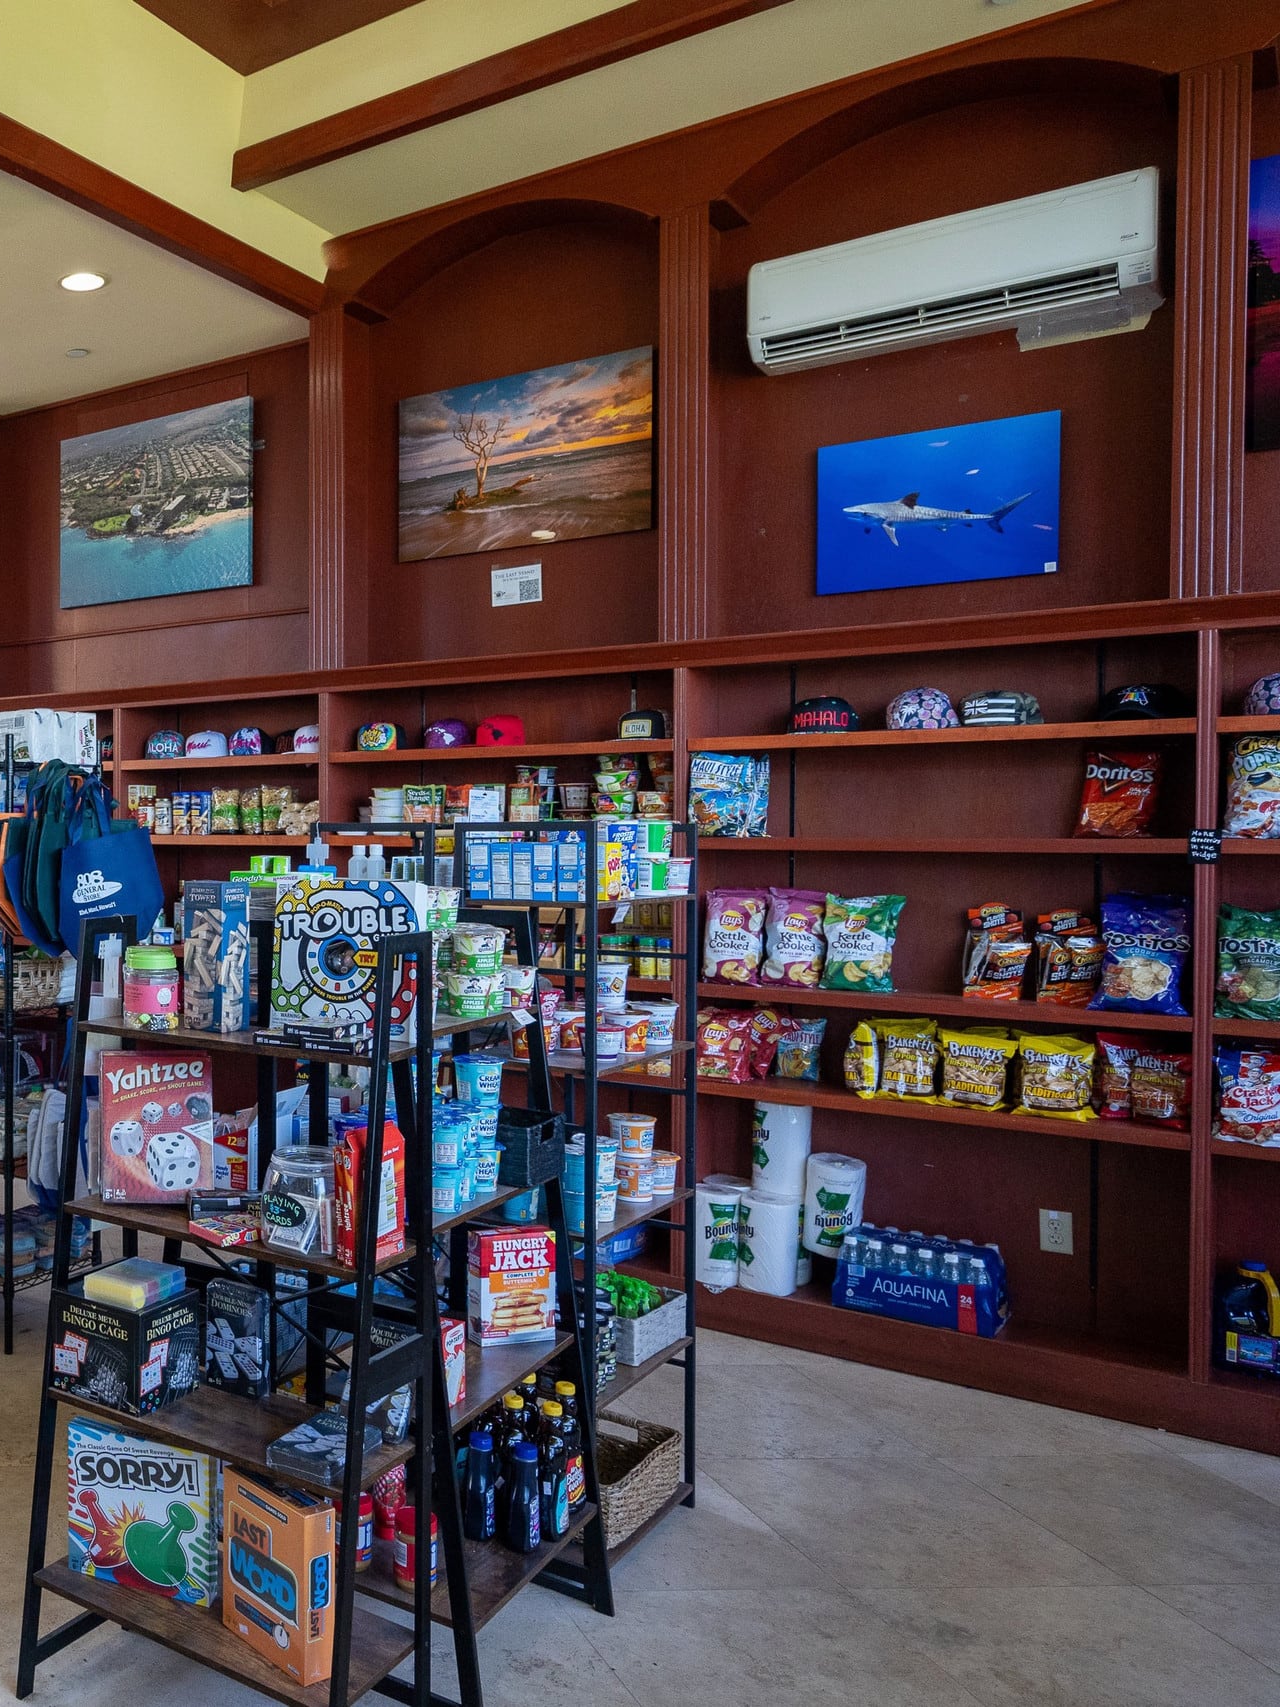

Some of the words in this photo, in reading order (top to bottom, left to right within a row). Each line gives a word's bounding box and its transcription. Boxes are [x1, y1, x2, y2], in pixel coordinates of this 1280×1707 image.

[794, 711, 848, 729] MAHALO
[625, 724, 646, 734] ALOHA
[148, 743, 179, 753] ALOHA
[692, 760, 715, 773] MAUI
[716, 763, 739, 775] STYLE
[1086, 764, 1154, 783] Doritos
[77, 870, 104, 889] 808
[233, 875, 264, 883] Goody's
[76, 884, 107, 898] GENERAL
[84, 893, 101, 902] STORE
[189, 894, 216, 904] TOWER
[224, 894, 246, 904] TOWER
[278, 906, 409, 940] TROUBLE
[983, 918, 1006, 929] SHOTS
[1053, 922, 1078, 932] SHOTS
[714, 931, 747, 940] Kettle
[781, 932, 812, 941] Kettle
[838, 932, 871, 941] Kettle
[1104, 932, 1191, 952] TOSTITOS
[709, 939, 750, 949] Cooked
[776, 941, 816, 952] Cooked
[831, 941, 874, 951] Cooked
[358, 953, 374, 963] TRY
[313, 986, 326, 999] MORE
[326, 993, 347, 1001] TROUBLE
[799, 1032, 822, 1044] STYLE
[106, 1060, 204, 1095] Yahtzee
[884, 1071, 932, 1084] TRADITIONAL
[120, 1093, 139, 1102] SHAKE,
[140, 1087, 158, 1096] SCORE,
[167, 1082, 186, 1090] SHOUT
[946, 1080, 998, 1095] TRADITIONAL
[1025, 1088, 1076, 1099] TRADITIONAL
[1241, 1096, 1274, 1109] Jack
[1243, 1111, 1278, 1123] Original
[227, 1136, 237, 1145] 12
[263, 1194, 301, 1217] PLAYING
[265, 1212, 293, 1226] CARDS
[343, 1203, 353, 1232] Yahtzee
[815, 1212, 854, 1227] Bounty
[705, 1222, 740, 1240] Bounty
[222, 1232, 241, 1247] UNO
[492, 1237, 548, 1252] HUNGRY
[490, 1249, 551, 1271] JACK
[872, 1277, 951, 1308] AQUAFINA
[960, 1295, 972, 1304] 24
[70, 1304, 97, 1321] DELUXE
[97, 1313, 122, 1328] METAL
[211, 1300, 253, 1318] DOMINOES
[151, 1313, 171, 1328] DELUXE
[170, 1306, 190, 1320] METAL
[62, 1311, 98, 1331] BINGO
[99, 1323, 129, 1342] CAGE
[146, 1322, 172, 1342] BINGO
[173, 1311, 195, 1329] CAGE
[87, 1443, 107, 1451] Classic
[131, 1447, 149, 1455] Sweet
[149, 1449, 175, 1458] Revenge
[77, 1454, 196, 1491] SORRY!
[233, 1512, 267, 1549] LAST
[232, 1544, 296, 1612] WORD
[313, 1555, 327, 1610] WORD
[310, 1611, 319, 1638] LAST
